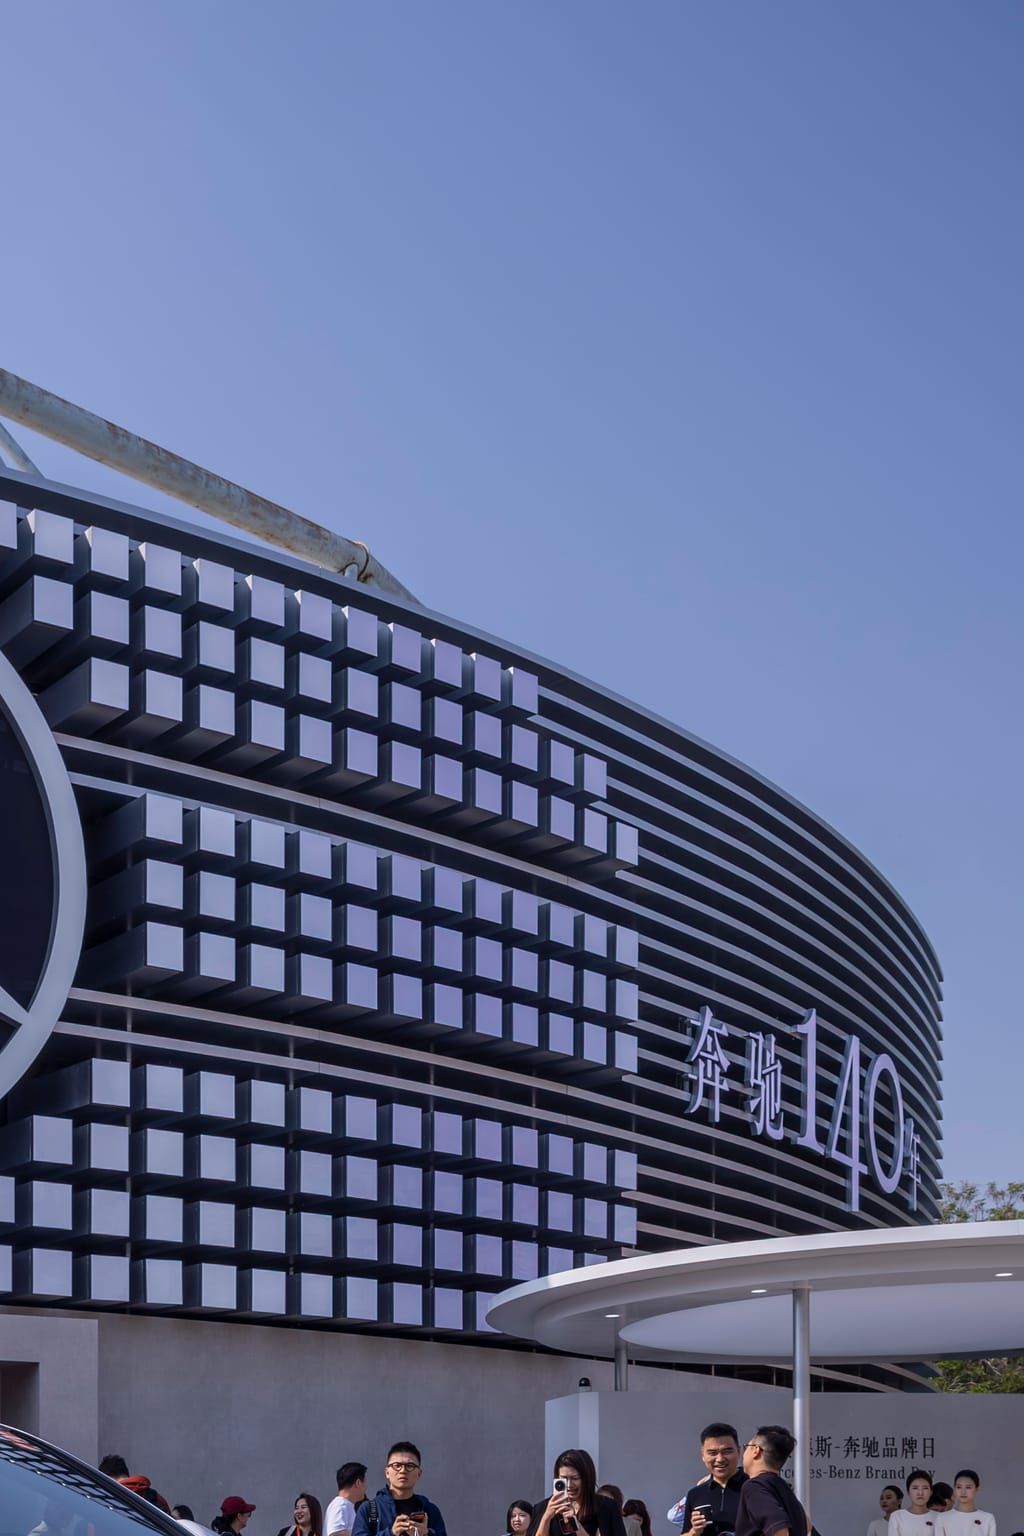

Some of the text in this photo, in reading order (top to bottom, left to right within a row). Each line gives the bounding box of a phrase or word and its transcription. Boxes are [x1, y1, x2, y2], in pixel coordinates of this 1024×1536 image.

[809, 1435, 935, 1459] 斯-奔驰品牌日
[866, 1465, 905, 1480] Brand
